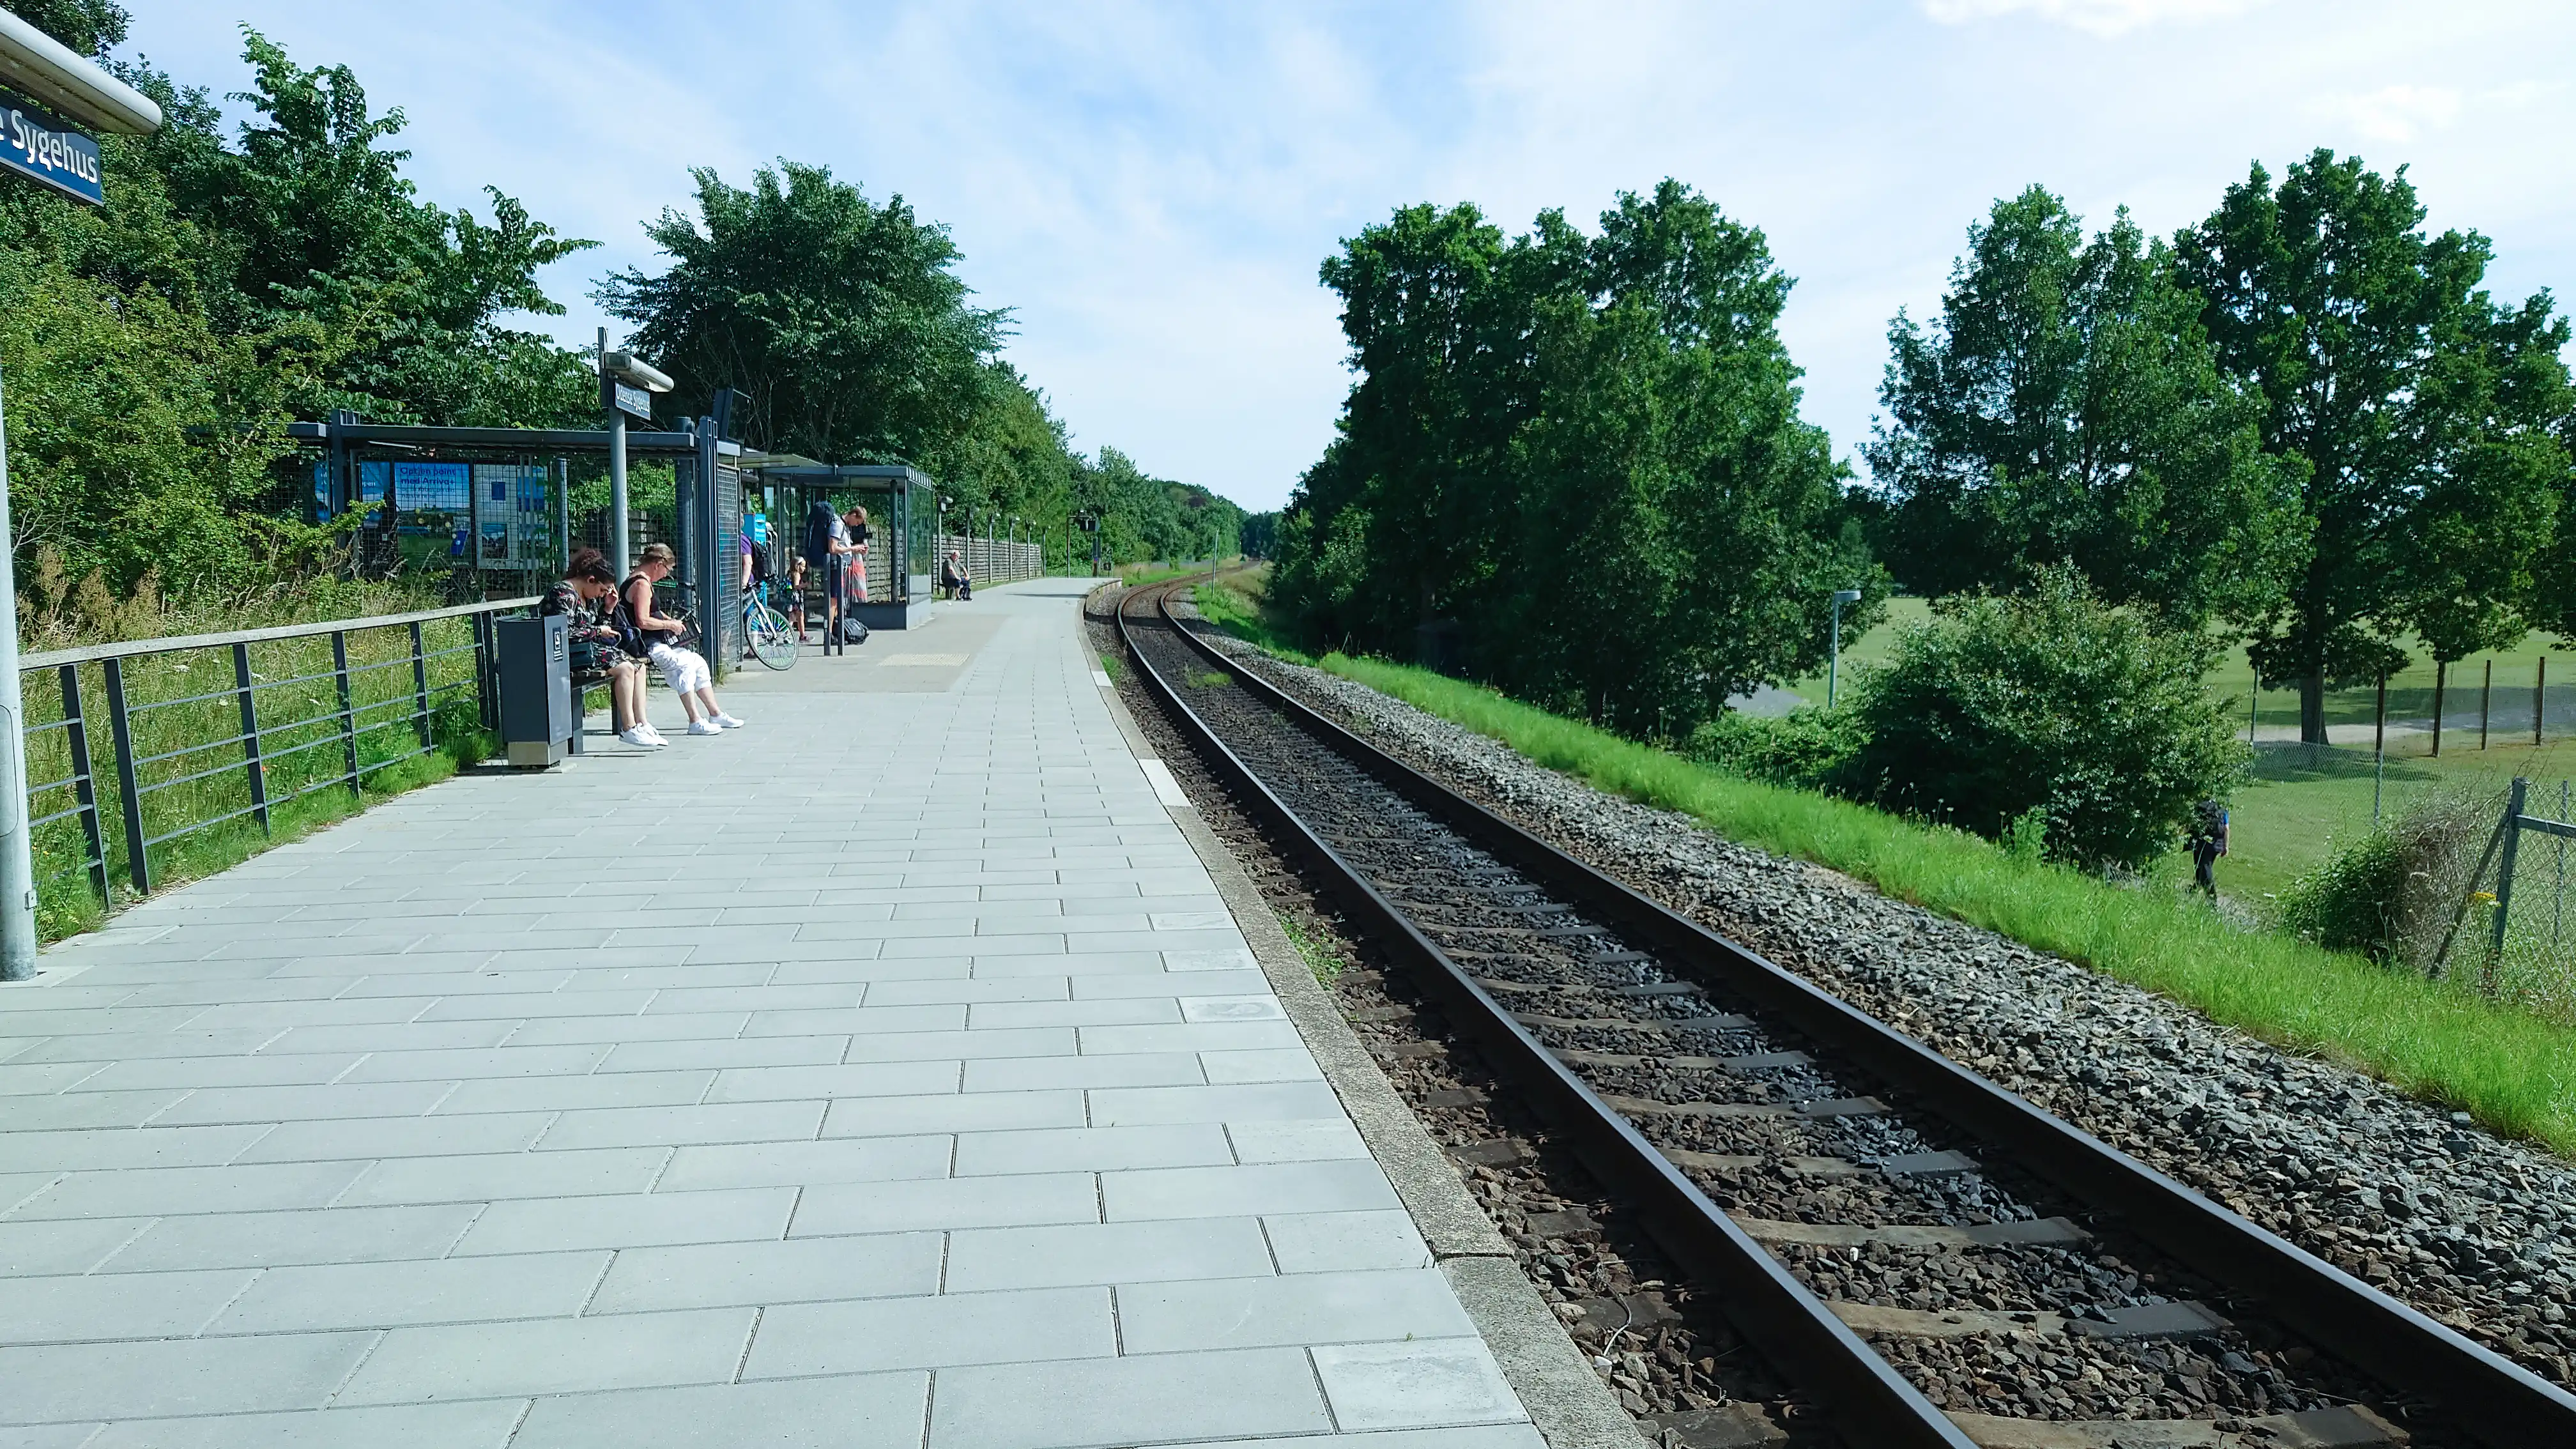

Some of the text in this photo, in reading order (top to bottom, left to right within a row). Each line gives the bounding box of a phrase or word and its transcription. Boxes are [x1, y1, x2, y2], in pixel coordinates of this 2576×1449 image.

[11, 109, 97, 183] Sygehus
[616, 383, 650, 412] Odense Sygehus
